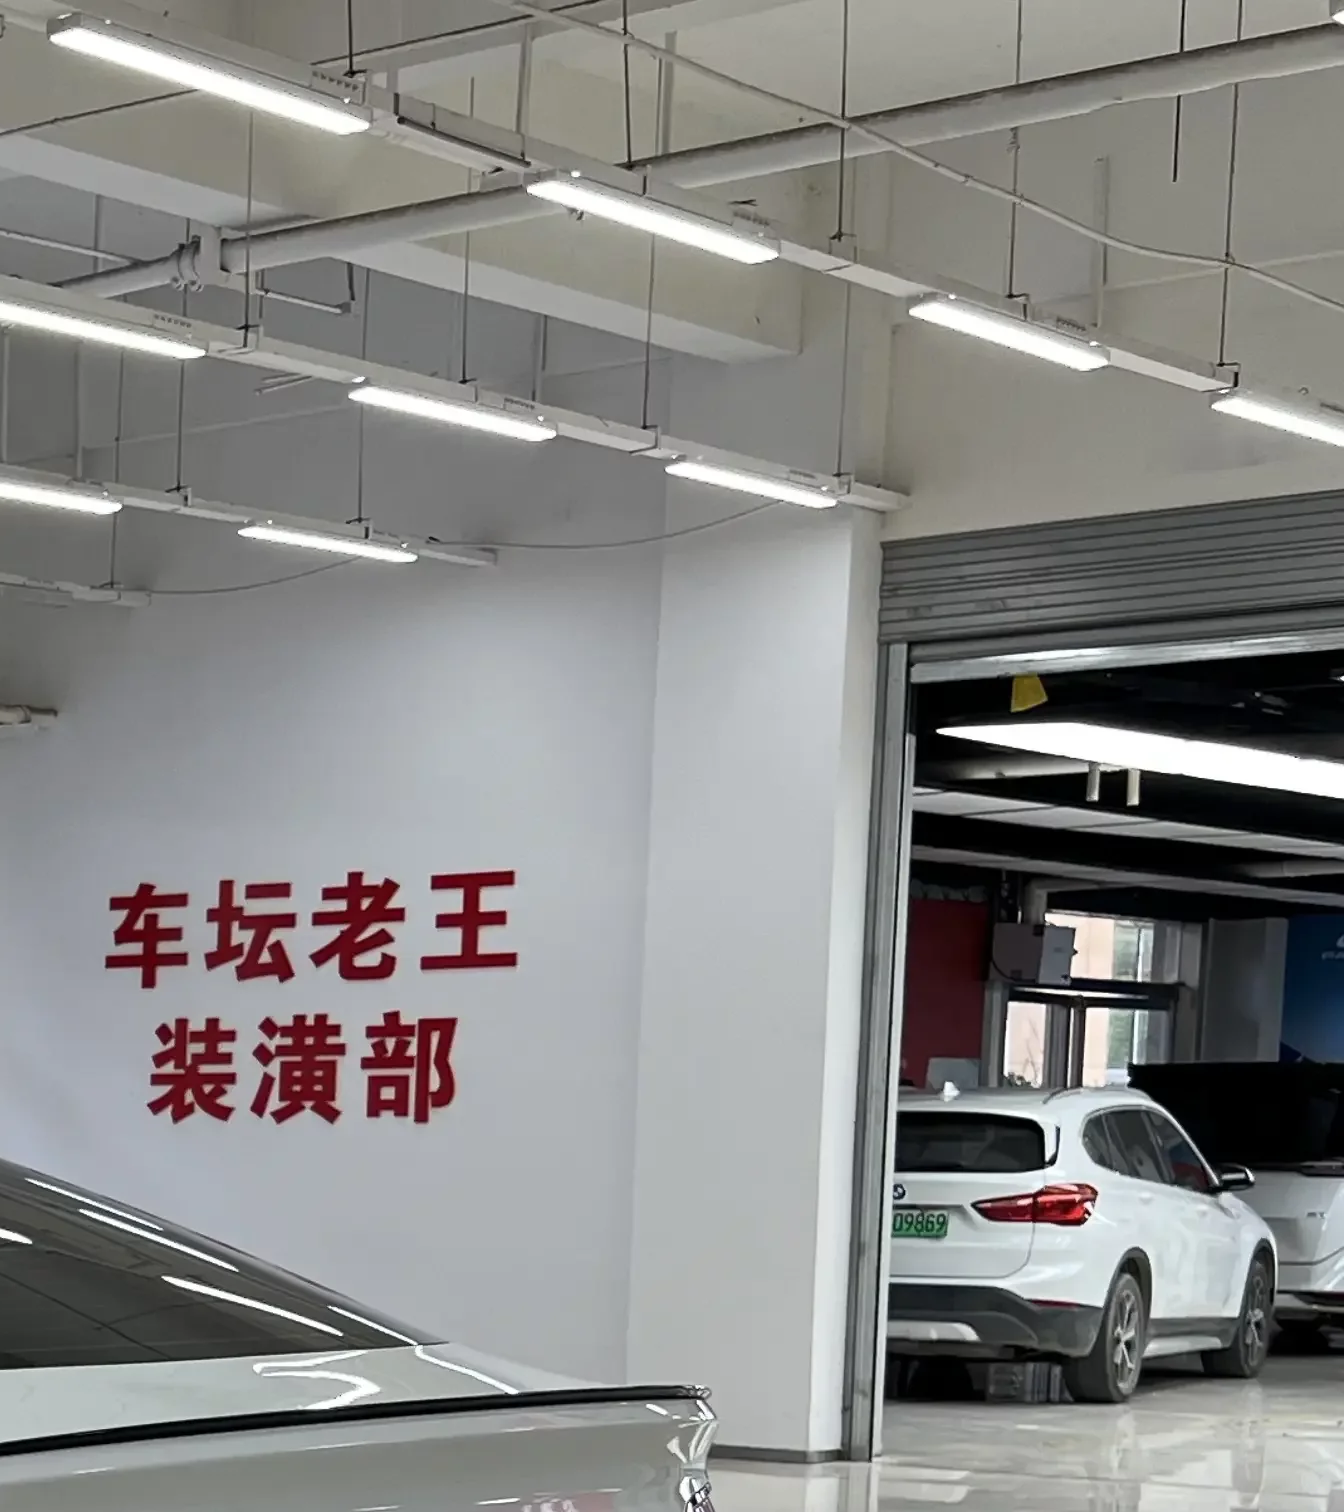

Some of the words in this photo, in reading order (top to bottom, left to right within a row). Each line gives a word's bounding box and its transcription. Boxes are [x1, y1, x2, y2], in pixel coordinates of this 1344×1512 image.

[105, 870, 519, 989] 车坛老王
[147, 1010, 458, 1124] 装潢部
